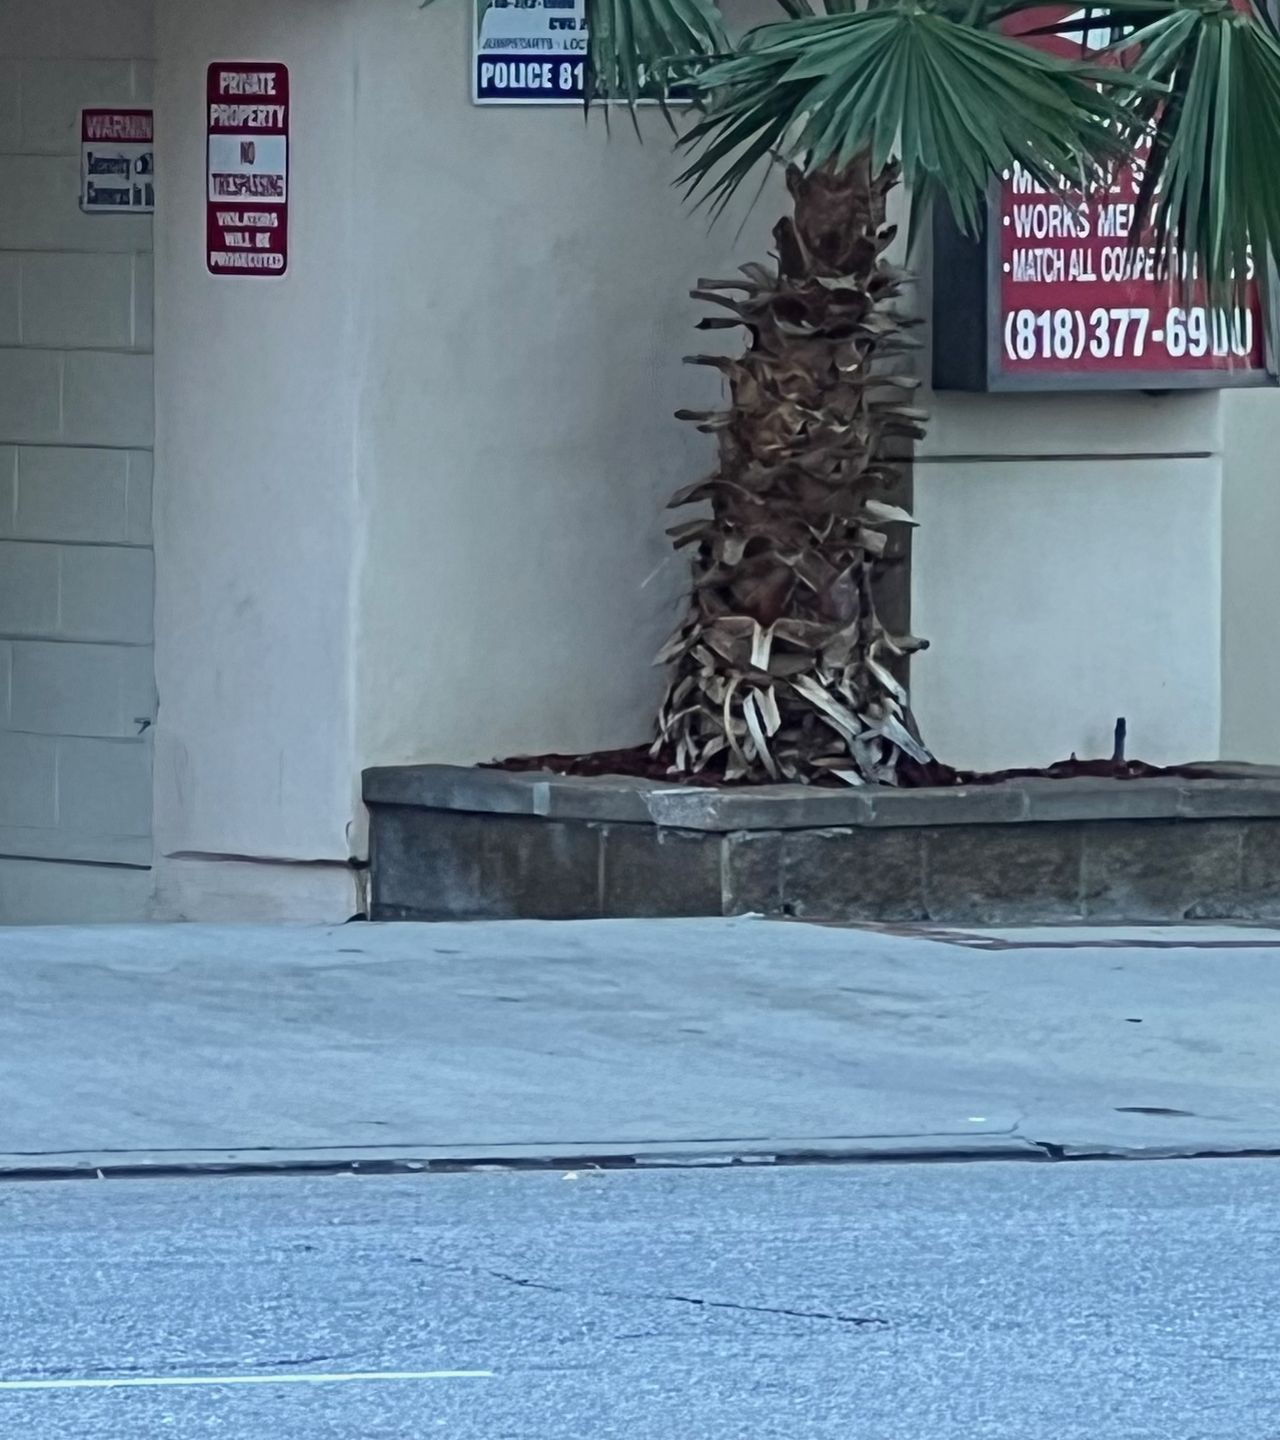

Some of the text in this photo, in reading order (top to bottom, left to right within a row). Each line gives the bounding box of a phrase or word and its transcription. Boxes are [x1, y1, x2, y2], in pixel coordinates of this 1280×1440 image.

[218, 71, 277, 96] PRIVATE
[480, 62, 554, 89] POLICE
[209, 103, 286, 128] PROPERTY
[1012, 203, 1091, 239] WORKS
[1012, 247, 1066, 283] MATCH
[1068, 247, 1098, 282] ALL
